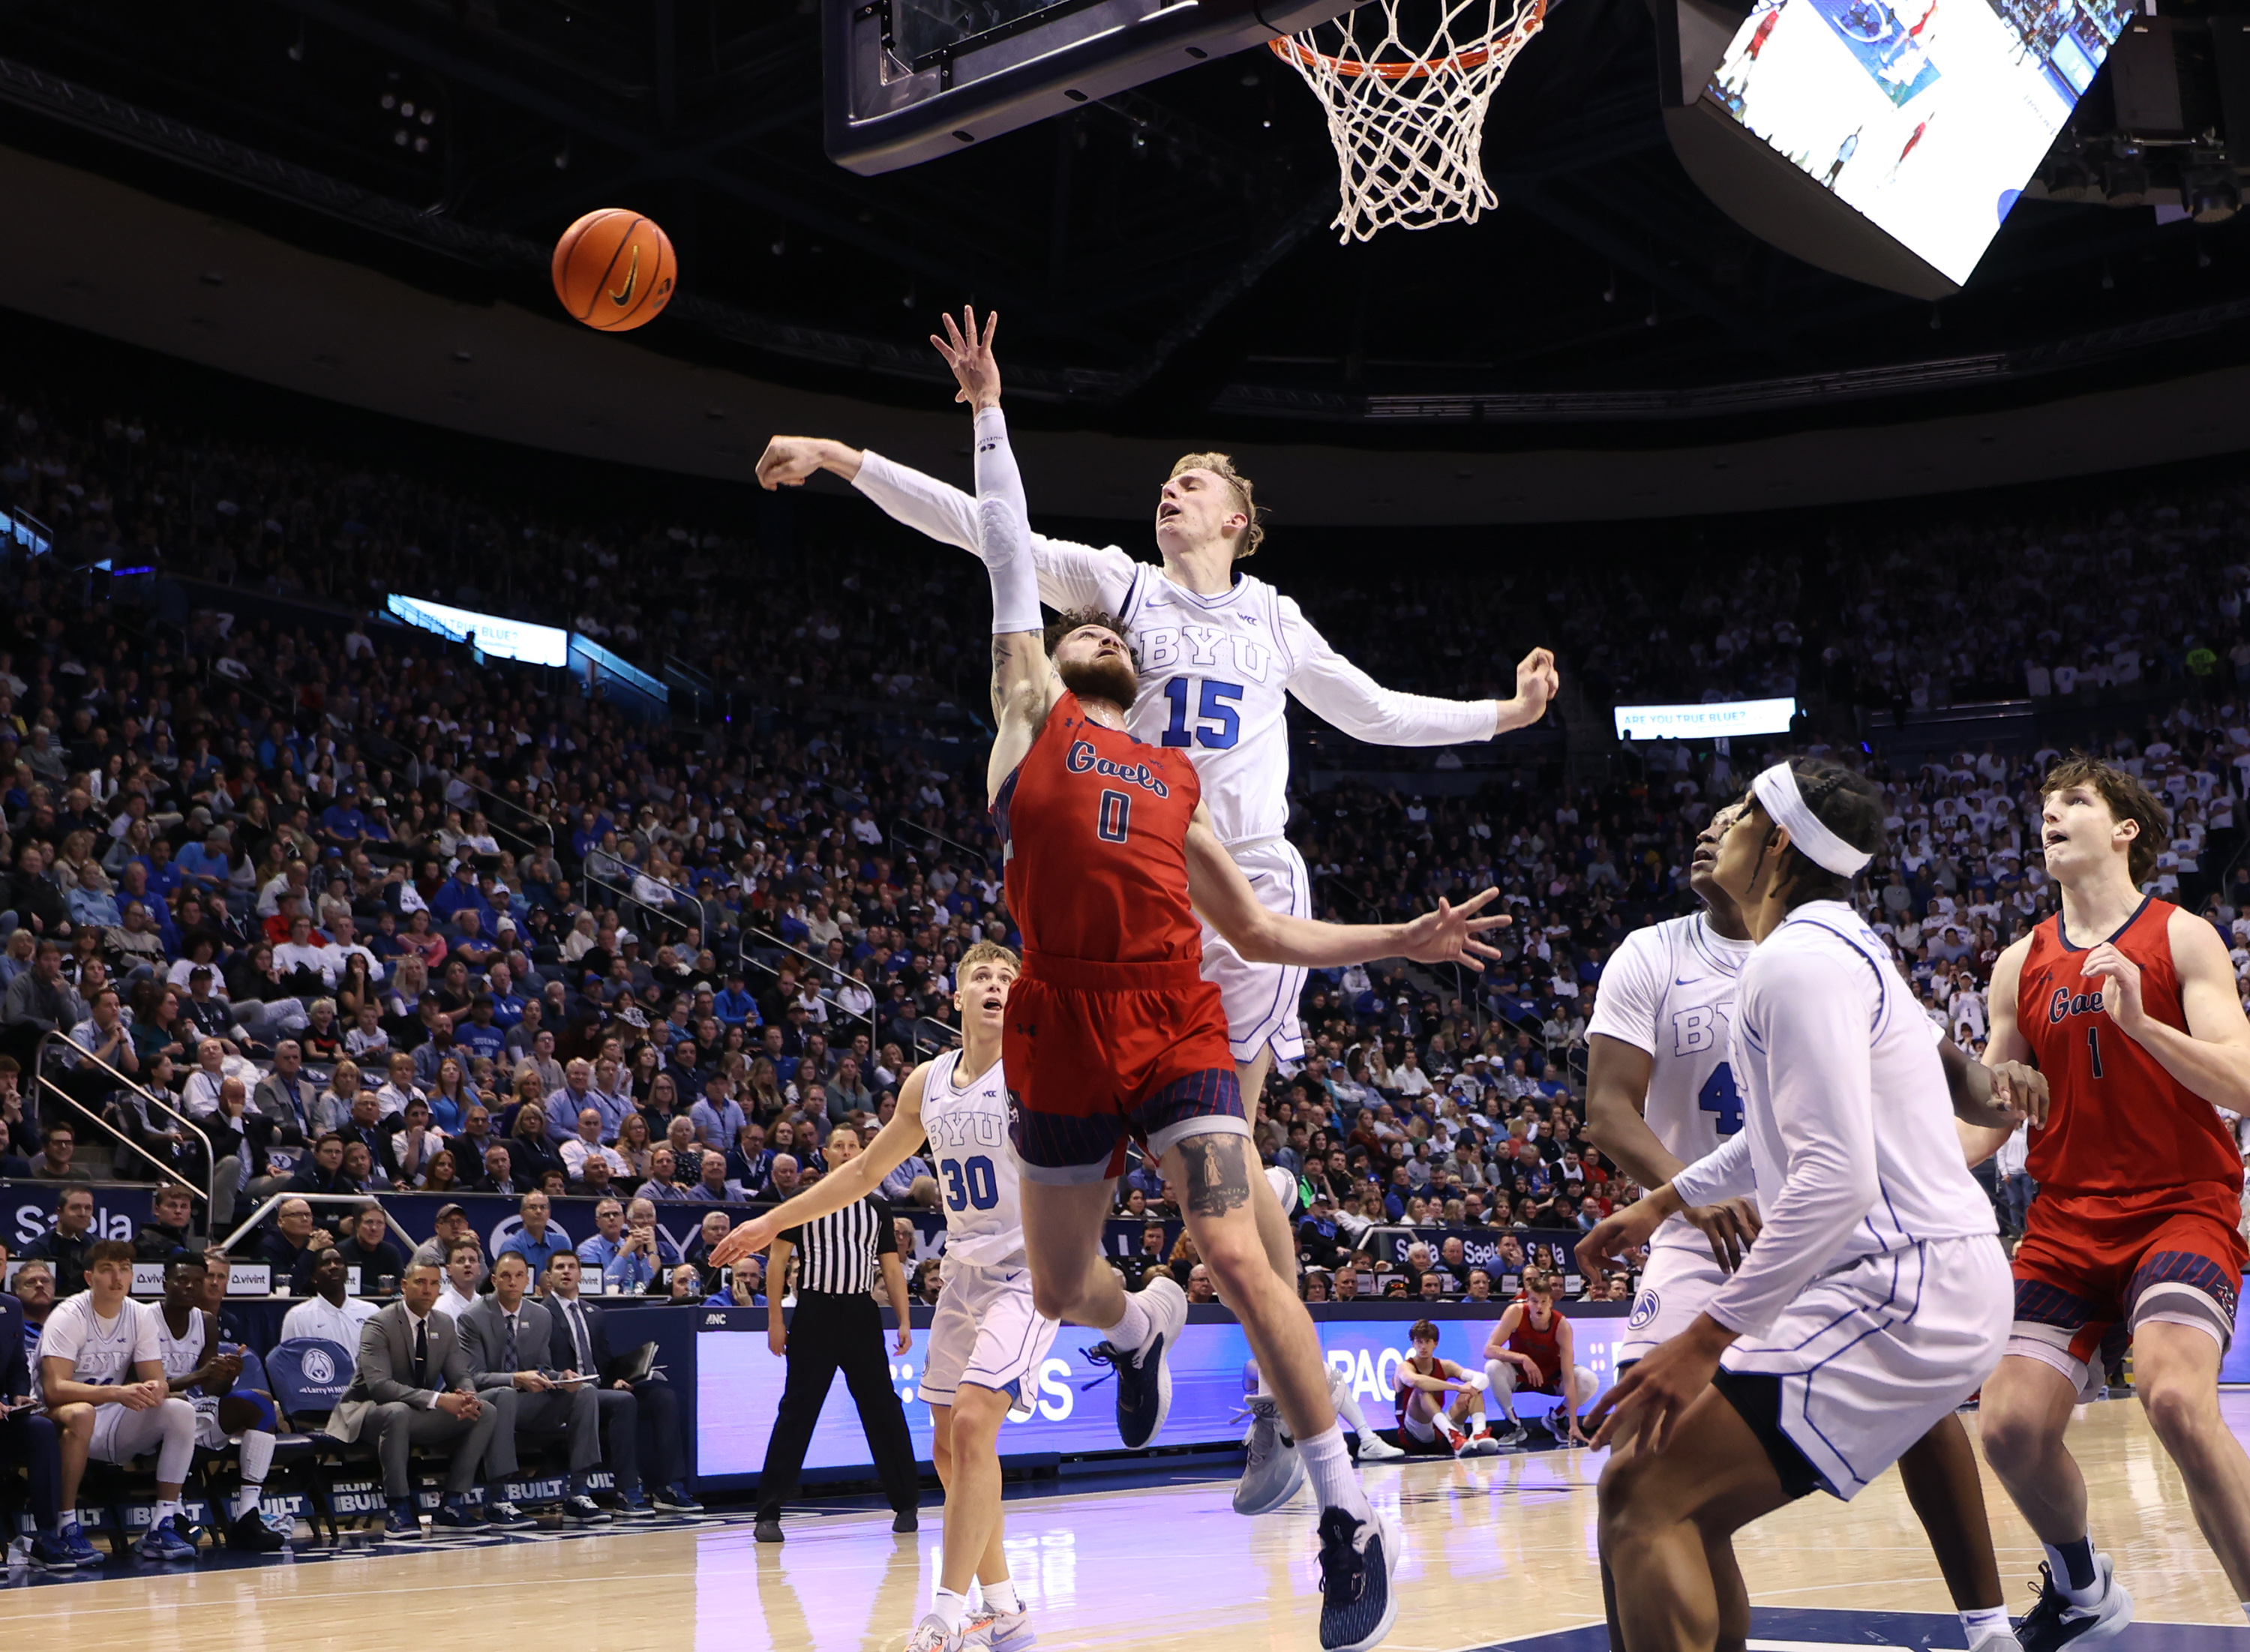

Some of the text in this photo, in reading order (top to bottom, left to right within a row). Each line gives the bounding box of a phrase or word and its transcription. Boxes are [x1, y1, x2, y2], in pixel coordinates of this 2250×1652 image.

[1237, 611, 1257, 627] WCC
[1139, 625, 1270, 683] BYU
[1161, 676, 1244, 750] 15
[1624, 711, 1747, 724] ARE YOU TRUE BLUE?
[1066, 739, 1169, 799] Gaels
[1096, 788, 1132, 844] 0
[2048, 986, 2104, 1025] Gae
[2086, 1026, 2104, 1079] 1
[1699, 1061, 1744, 1135] 4
[925, 1111, 1003, 1153] BYU
[940, 1154, 999, 1213] 30
[1463, 1240, 1498, 1264] Sael
[1527, 1242, 1565, 1265] Sla
[241, 1274, 266, 1285] vivint
[705, 1313, 727, 1325] ANC
[1328, 1347, 1417, 1402] PAC
[306, 1386, 327, 1395] Larry
[508, 1480, 562, 1500] BUILT
[586, 1473, 615, 1489] UIL
[259, 1496, 303, 1515] UILT
[338, 1495, 388, 1513] BUIL
[426, 1487, 484, 1508] BLT
